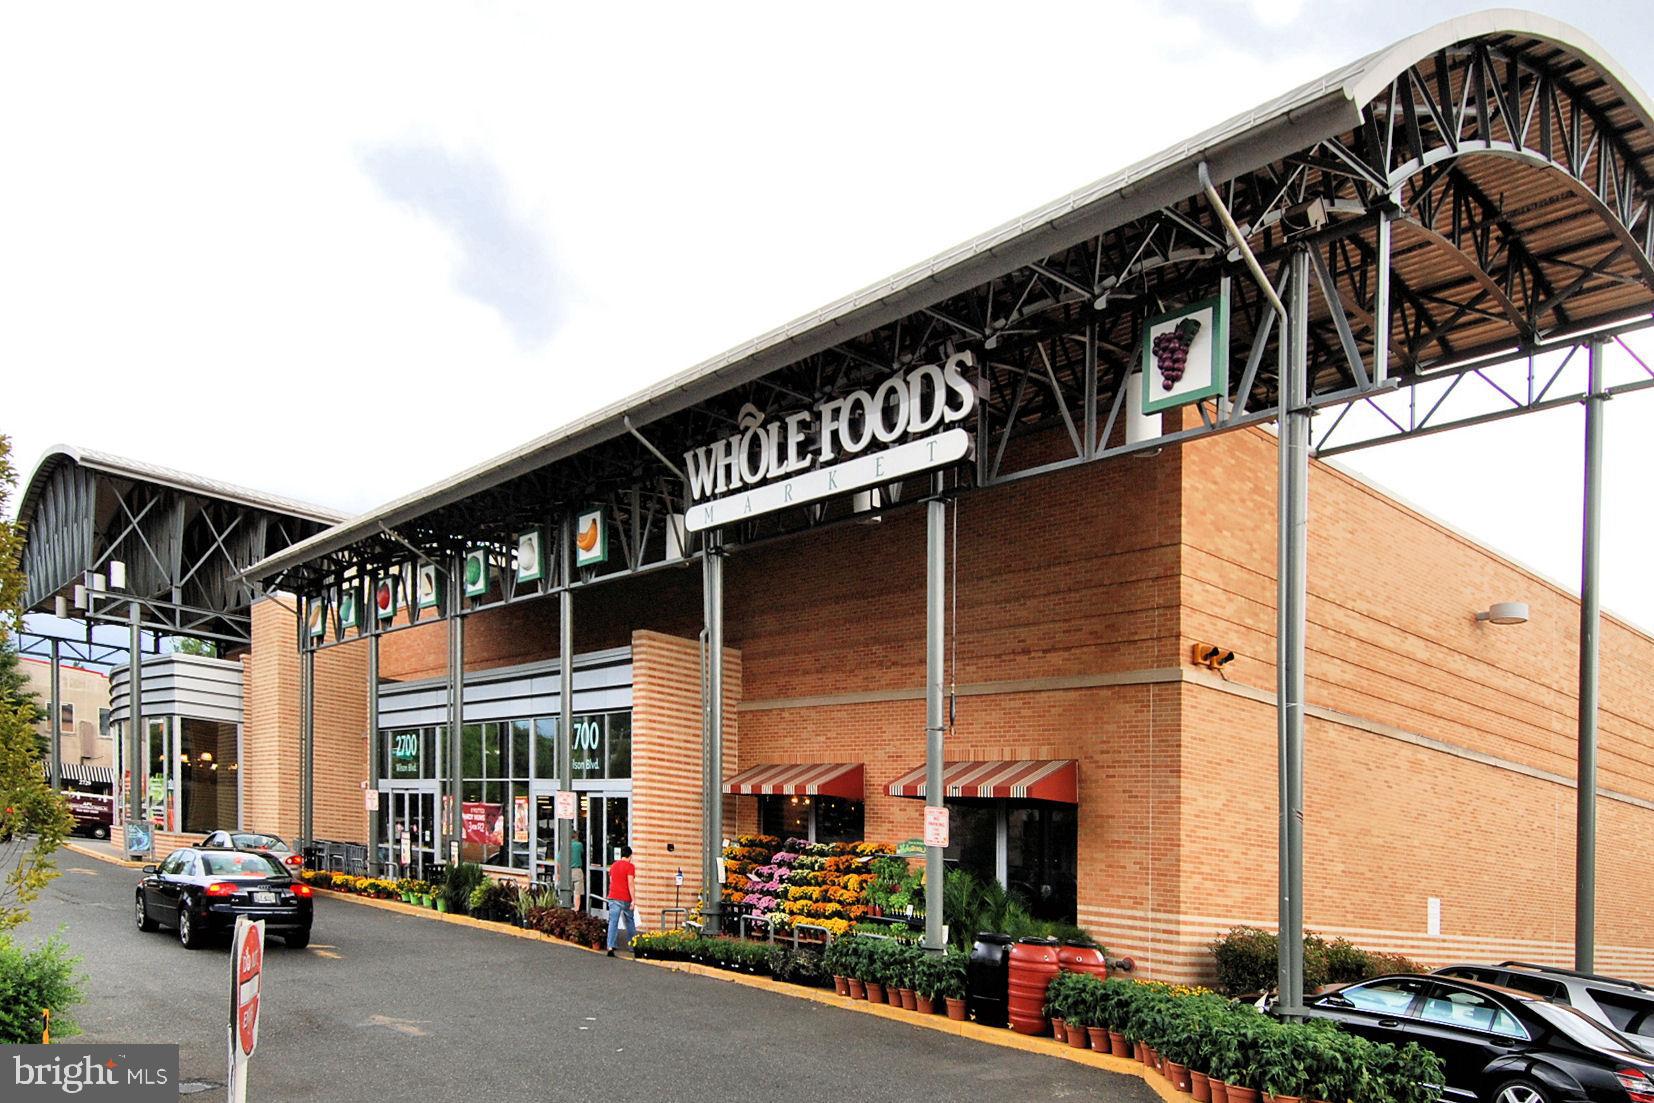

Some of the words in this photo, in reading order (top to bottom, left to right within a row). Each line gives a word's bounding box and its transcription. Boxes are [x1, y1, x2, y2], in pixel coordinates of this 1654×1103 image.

[683, 409, 811, 500] WHOLE
[818, 350, 975, 463] FOODS
[704, 441, 938, 524] MARKET
[396, 733, 417, 756] 2700
[572, 722, 599, 750] 700
